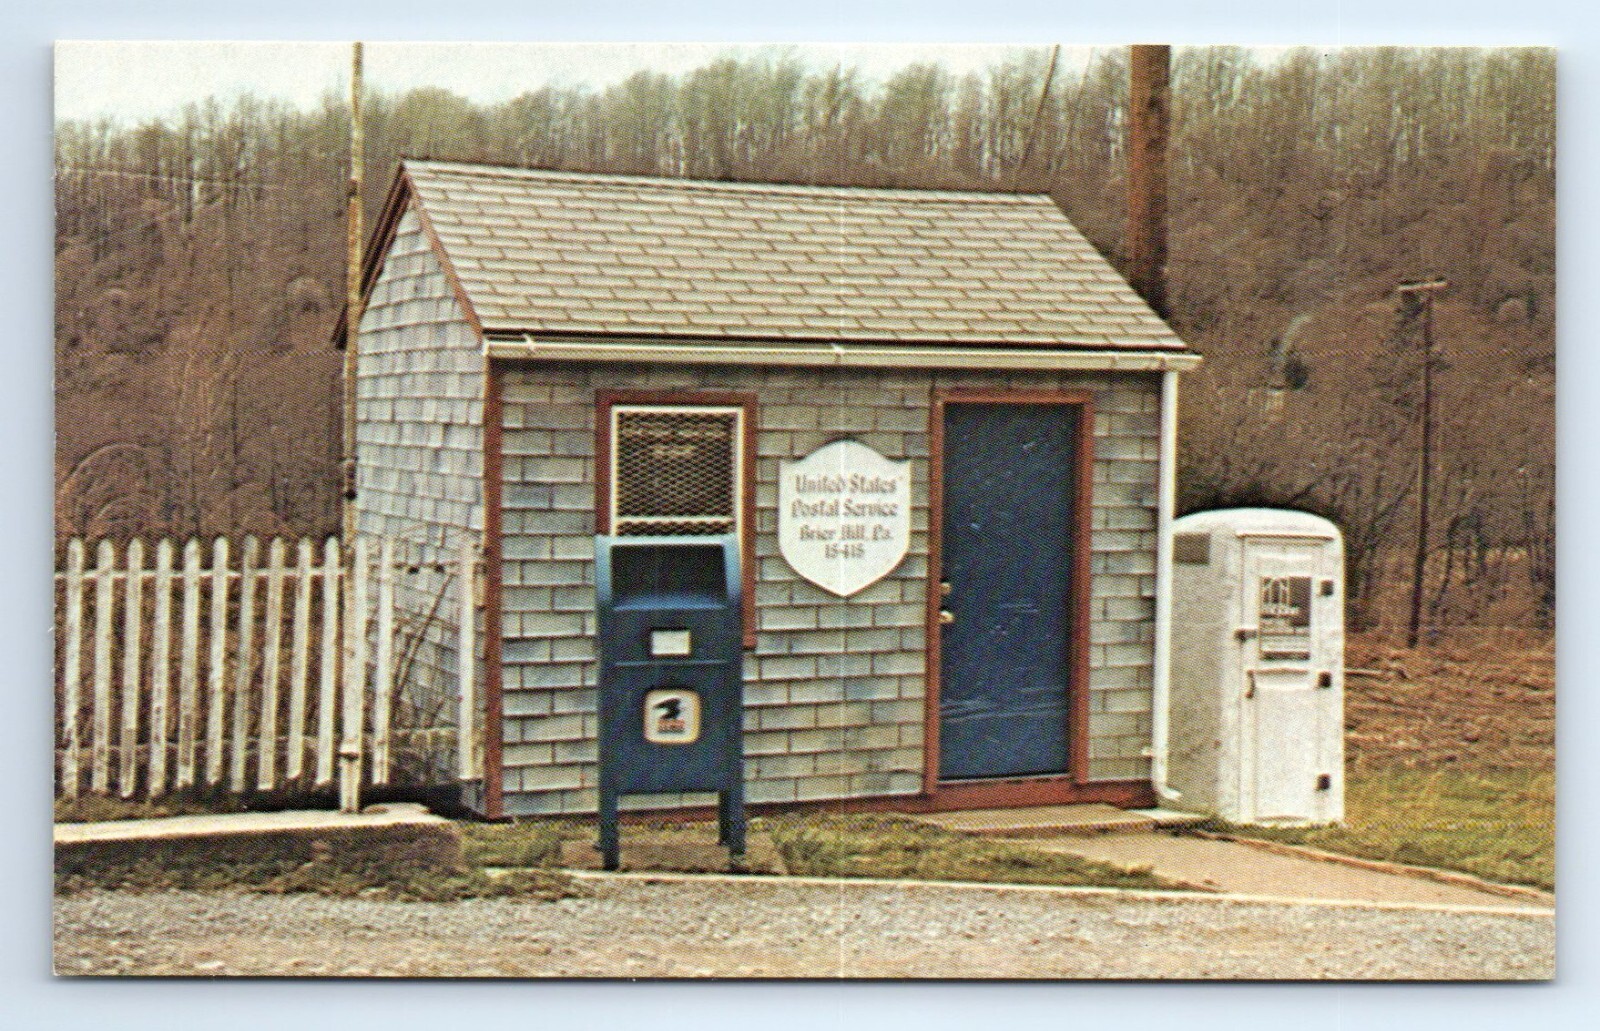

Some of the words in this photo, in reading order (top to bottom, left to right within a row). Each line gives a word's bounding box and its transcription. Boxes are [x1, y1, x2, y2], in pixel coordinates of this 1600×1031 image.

[795, 473, 845, 494] United
[850, 473, 896, 494] States
[791, 498, 839, 517] Postal
[843, 498, 898, 517] Service
